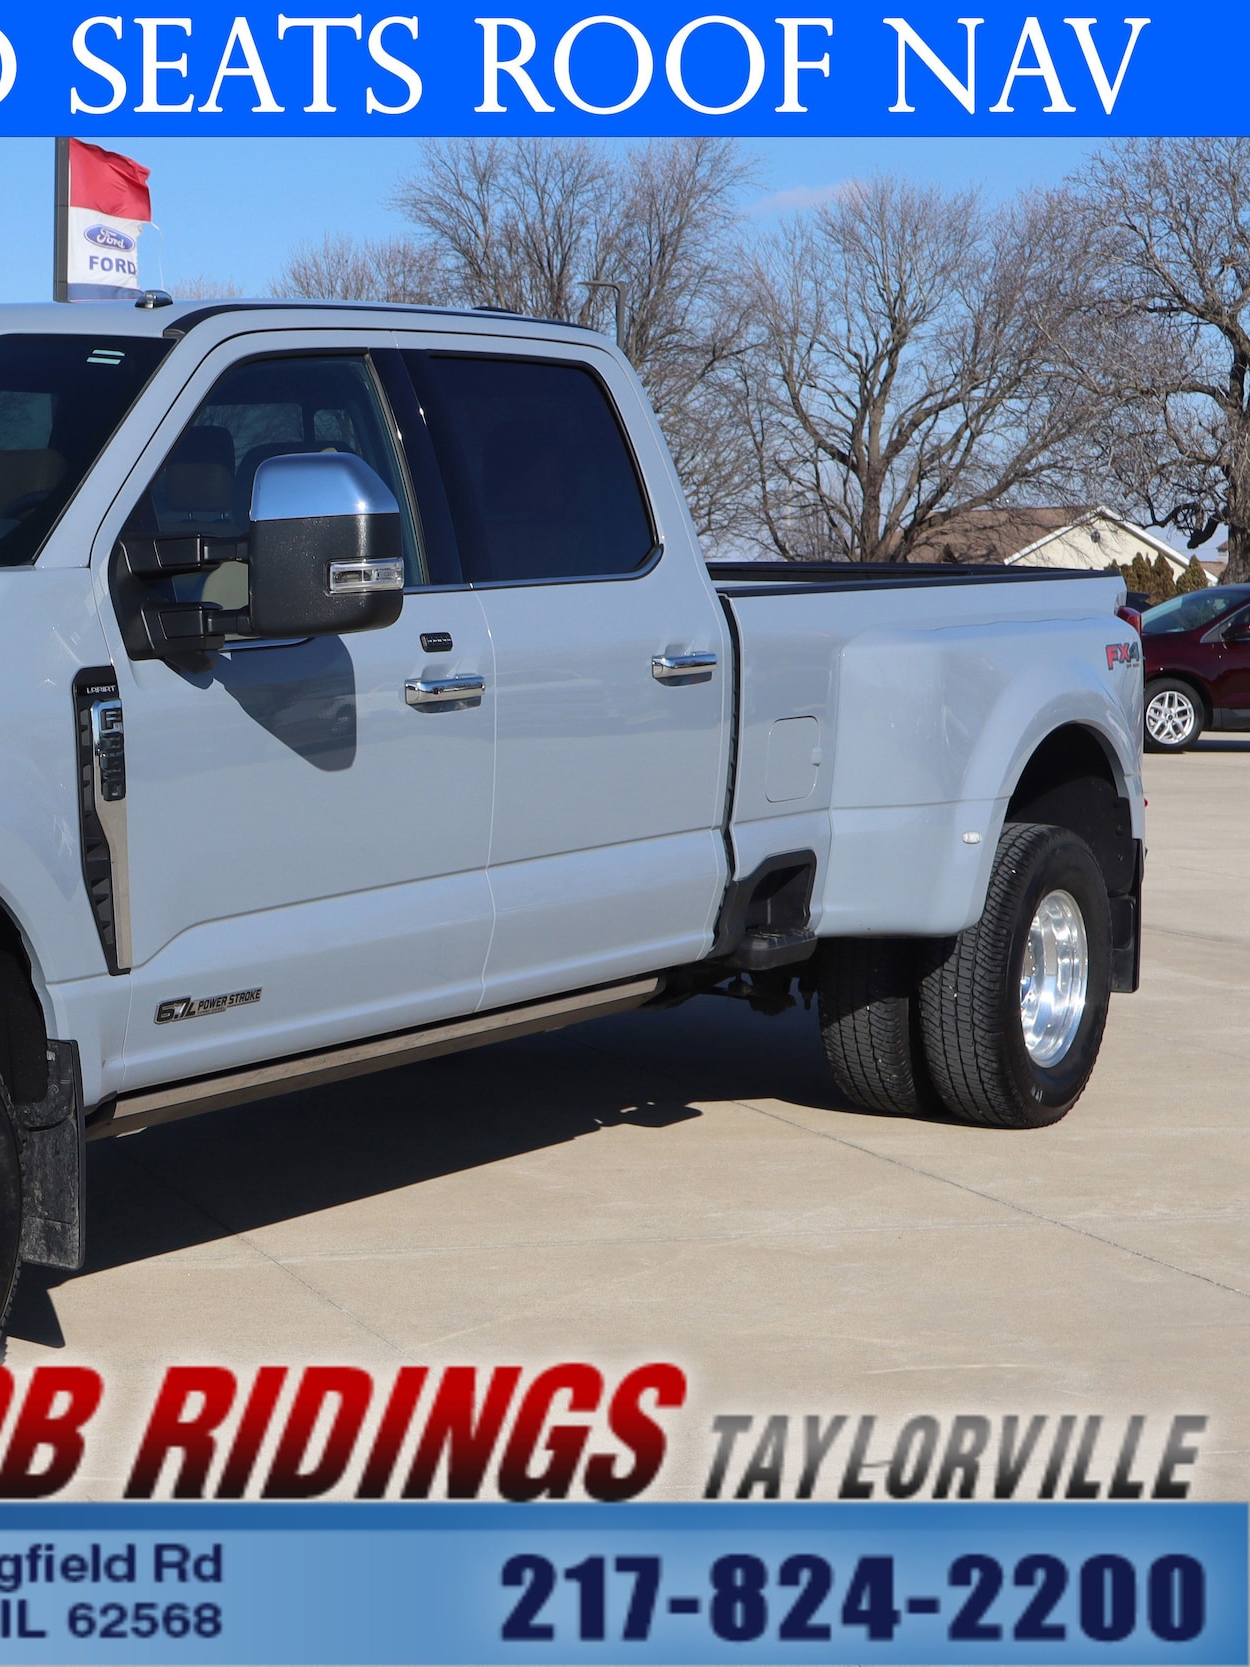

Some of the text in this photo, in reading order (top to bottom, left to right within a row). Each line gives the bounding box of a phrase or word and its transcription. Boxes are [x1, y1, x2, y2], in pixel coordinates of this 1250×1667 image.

[96, 228, 126, 248] Ford
[89, 255, 137, 275] FORD
[1105, 642, 1140, 671] FX4
[156, 998, 197, 1022] 6.7L
[198, 996, 228, 1011] POWER
[228, 989, 263, 1005] STROKE
